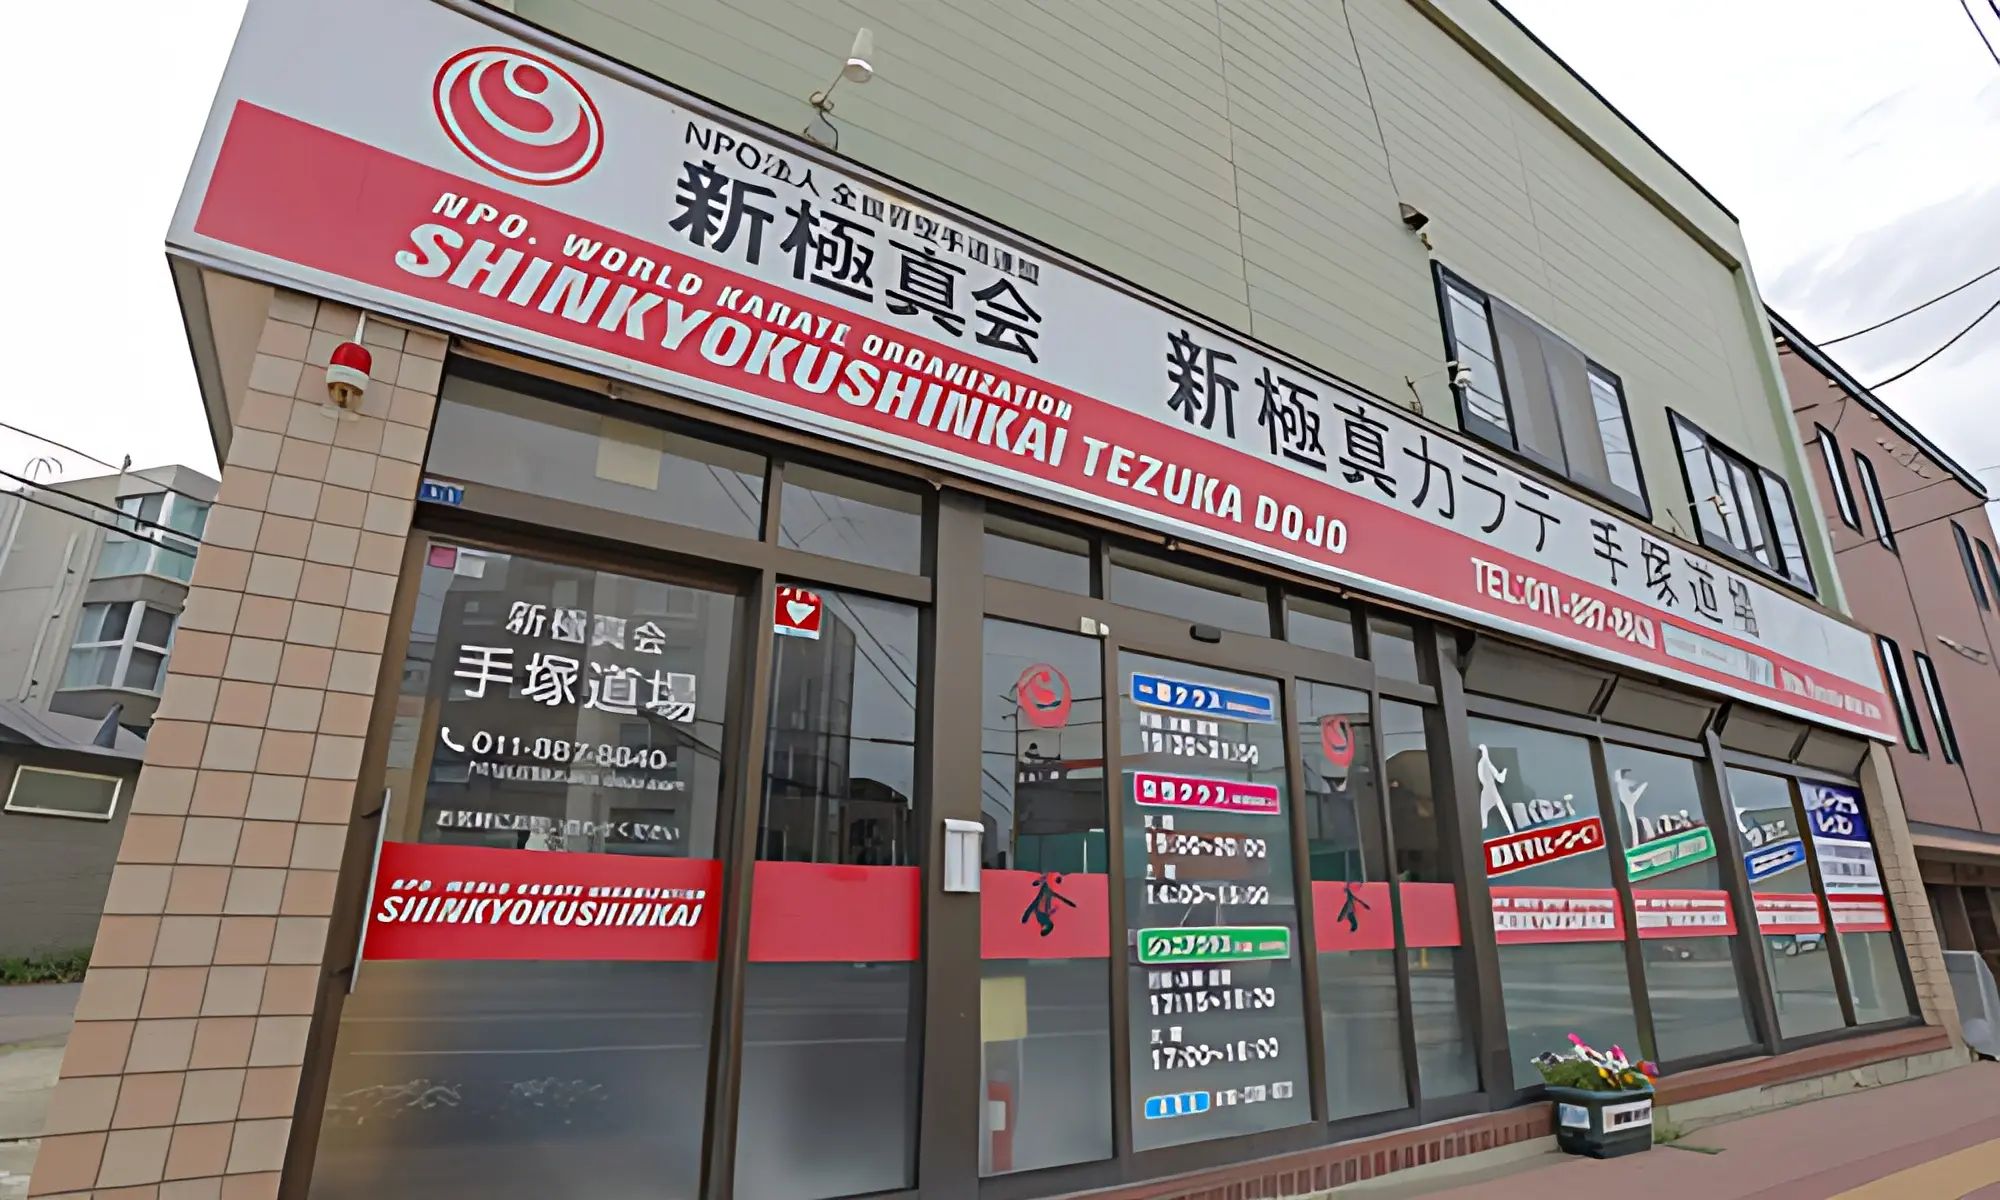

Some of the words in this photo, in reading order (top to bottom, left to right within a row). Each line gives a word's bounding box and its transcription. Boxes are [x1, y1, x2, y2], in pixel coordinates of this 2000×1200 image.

[562, 233, 703, 297] WORLD
[717, 286, 852, 348] KARATE
[668, 159, 1043, 364] 新極真会
[395, 223, 1068, 468] SHINKYOKUSHINKAI
[1083, 436, 1243, 523] TEZUKA
[1254, 494, 1348, 555] DOJO
[1165, 330, 1561, 554] 新極真カラテ
[454, 644, 698, 724] 手塚道場
